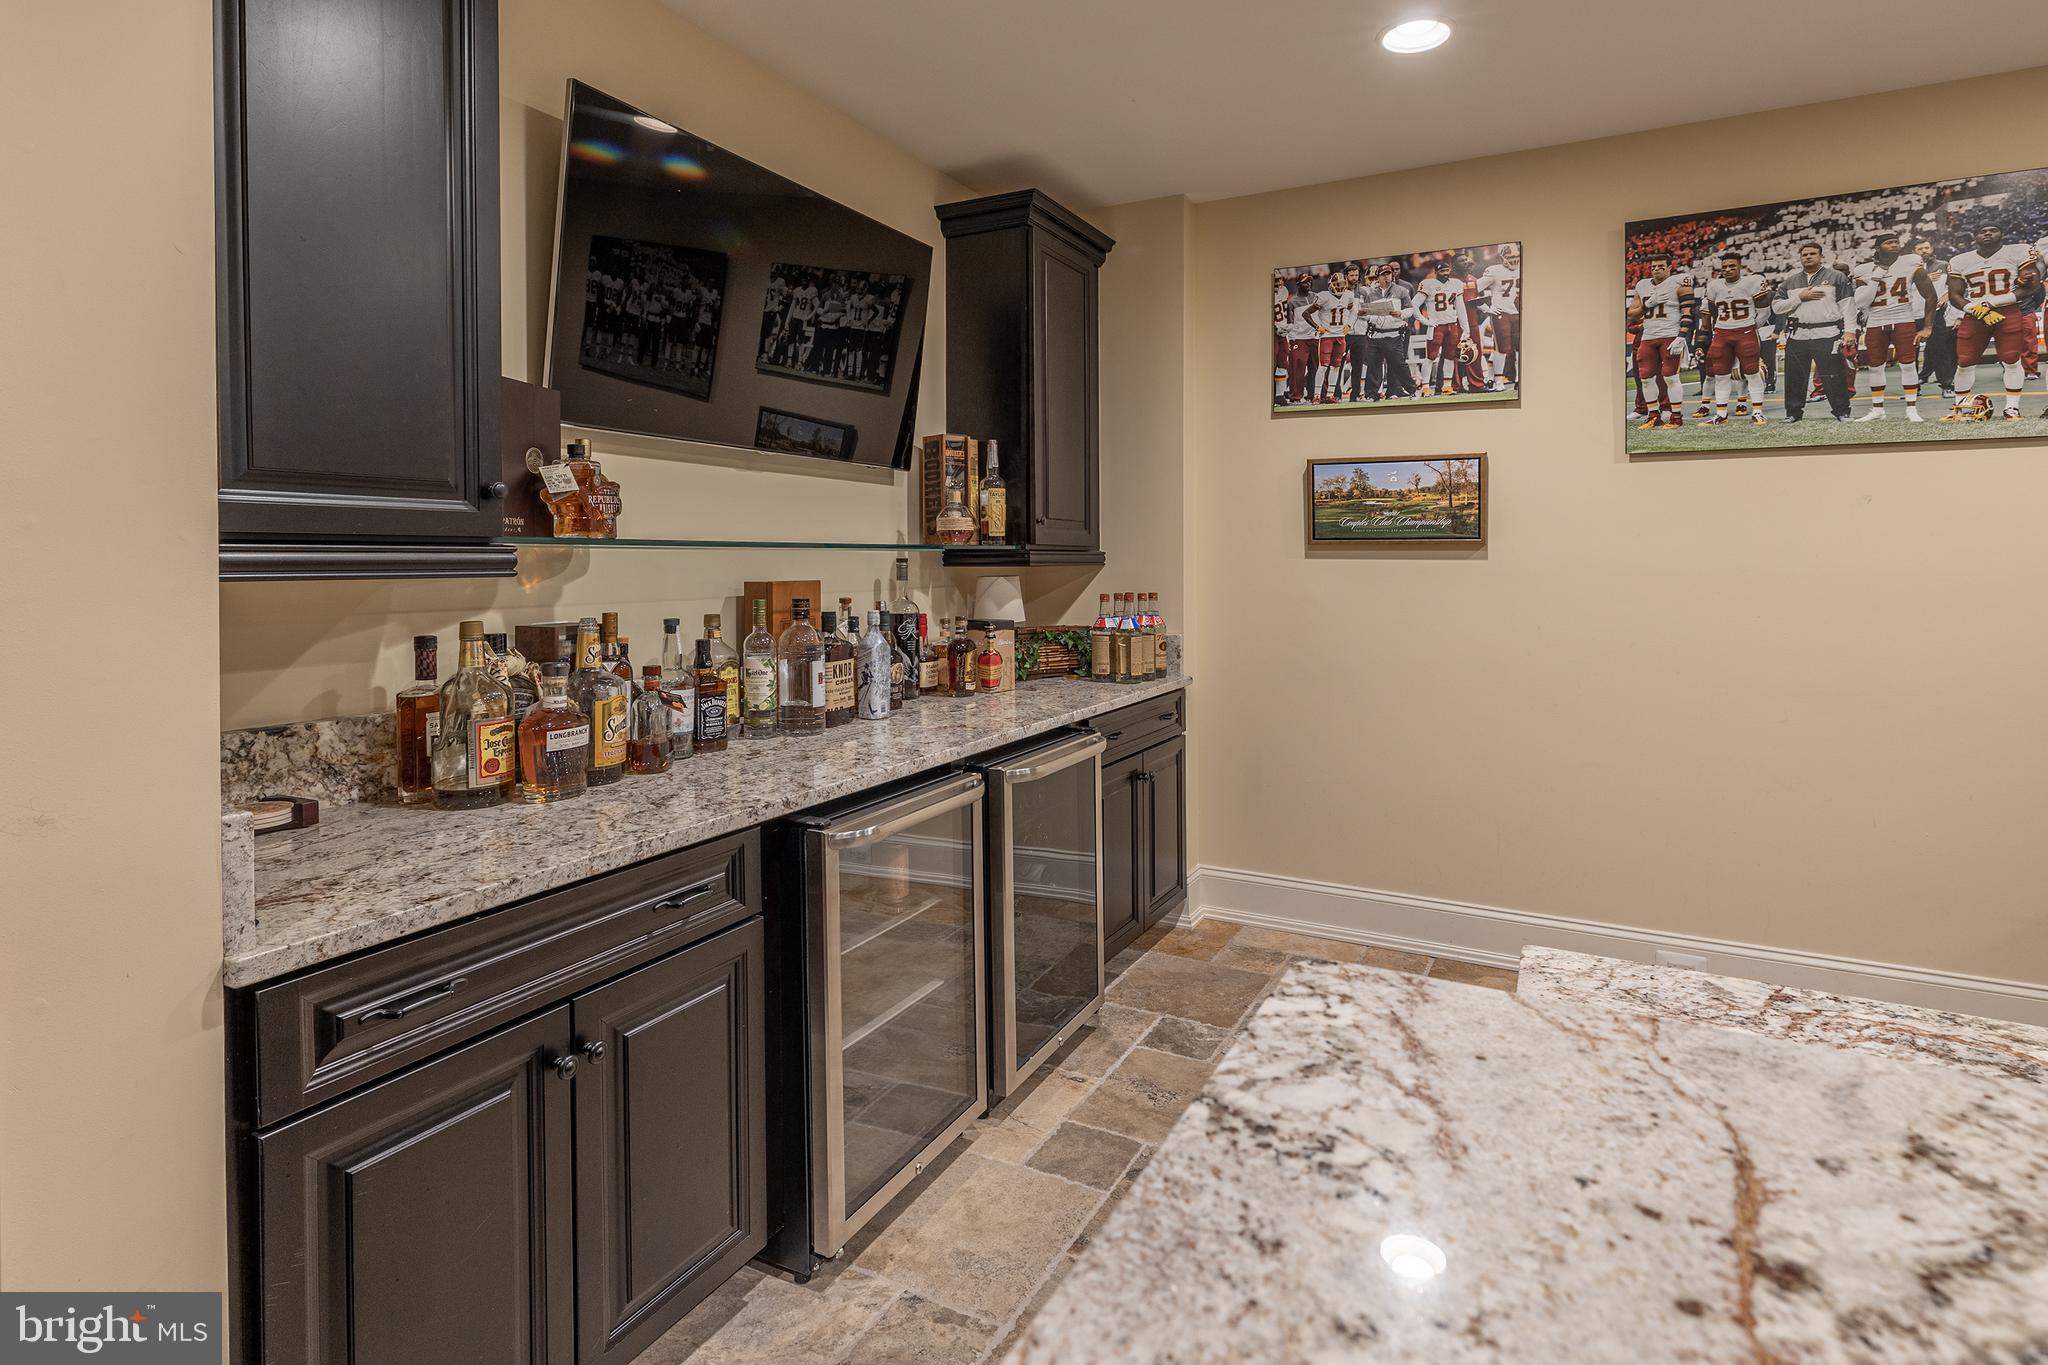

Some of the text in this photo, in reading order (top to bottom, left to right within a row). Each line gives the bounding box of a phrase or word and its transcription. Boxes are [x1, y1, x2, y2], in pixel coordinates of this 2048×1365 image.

[1871, 276, 1909, 307] 24
[1964, 268, 2012, 298] 50
[1435, 292, 1457, 312] 84
[1716, 298, 1750, 321] 36
[1330, 307, 1345, 327] 11
[588, 495, 621, 507] REPUBLIC
[1371, 516, 1393, 527] Club
[1395, 516, 1452, 529] Championship
[832, 662, 852, 679] KNOB
[549, 727, 588, 741] LONGBRANCH
[484, 738, 501, 751] Jose
